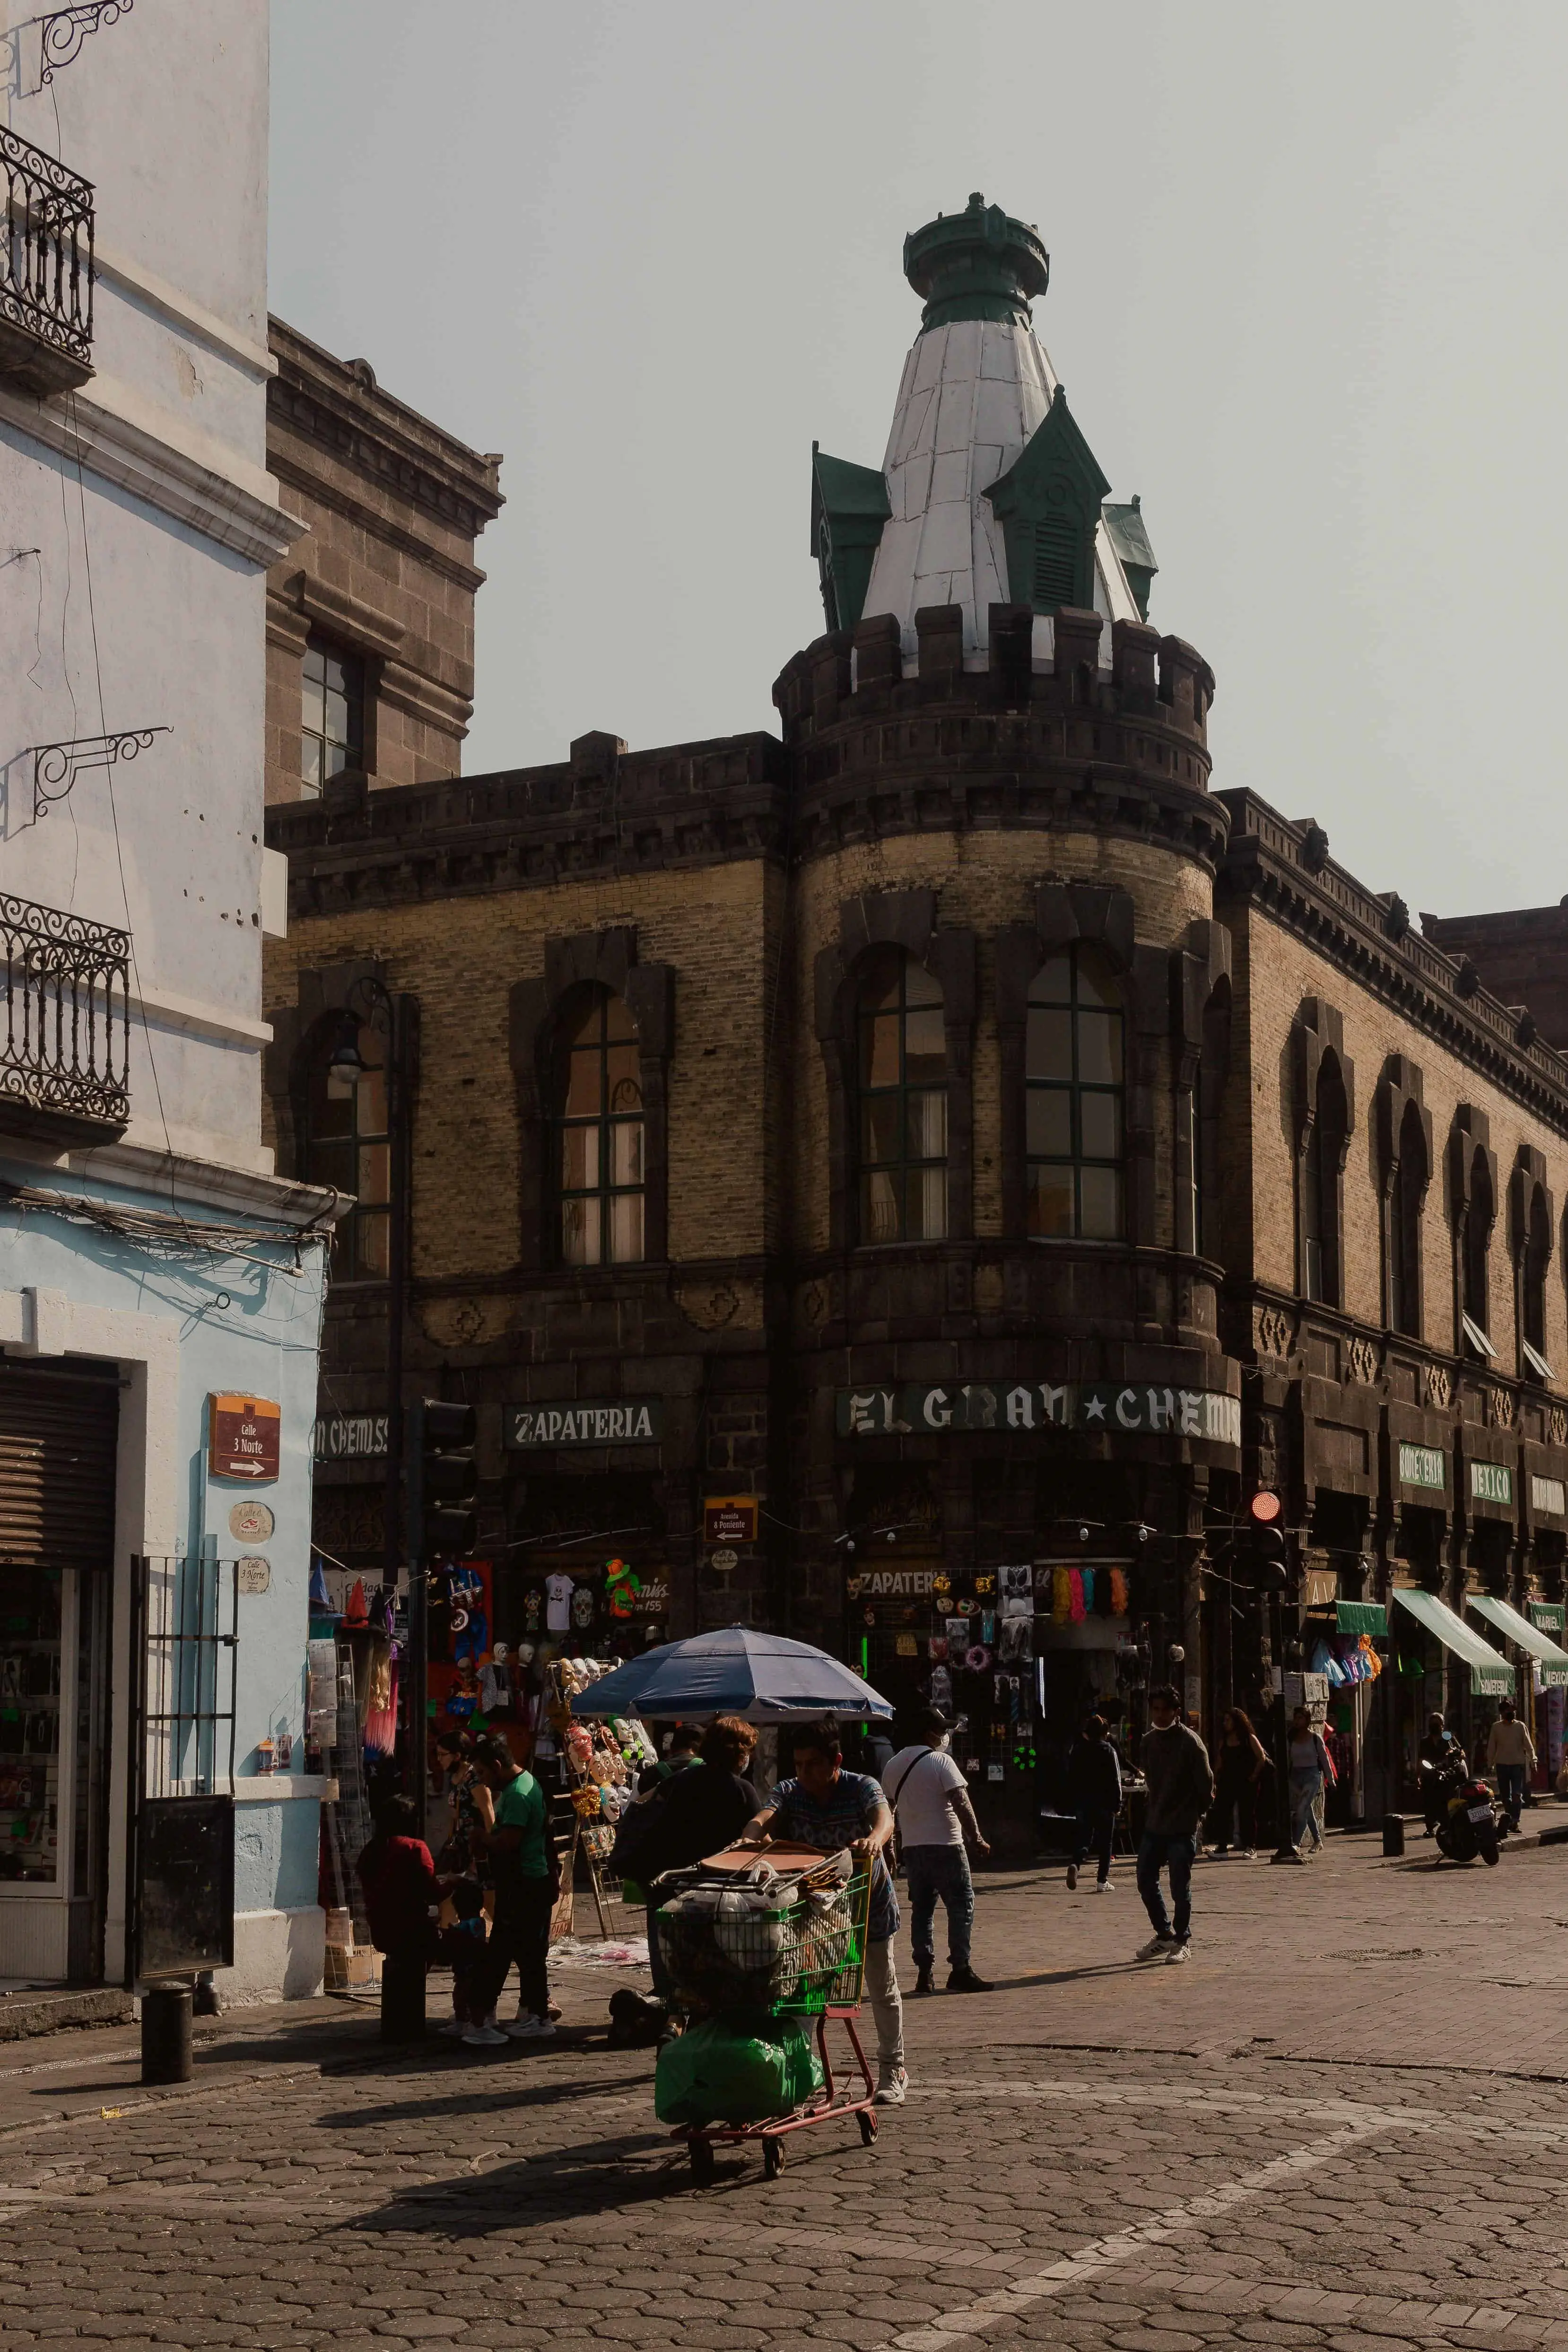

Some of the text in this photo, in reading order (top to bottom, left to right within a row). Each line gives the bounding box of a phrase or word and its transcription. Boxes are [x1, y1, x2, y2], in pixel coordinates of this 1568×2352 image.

[242, 1424, 257, 1436] Calle
[515, 1407, 653, 1443] ZAPATERIA
[234, 1437, 263, 1454] 3 Norte
[714, 1520, 746, 1529] 8 Poniente
[241, 1568, 265, 1581] 3 Norte
[860, 1571, 946, 1594] ZAPATER
[645, 1600, 662, 1612] 155
